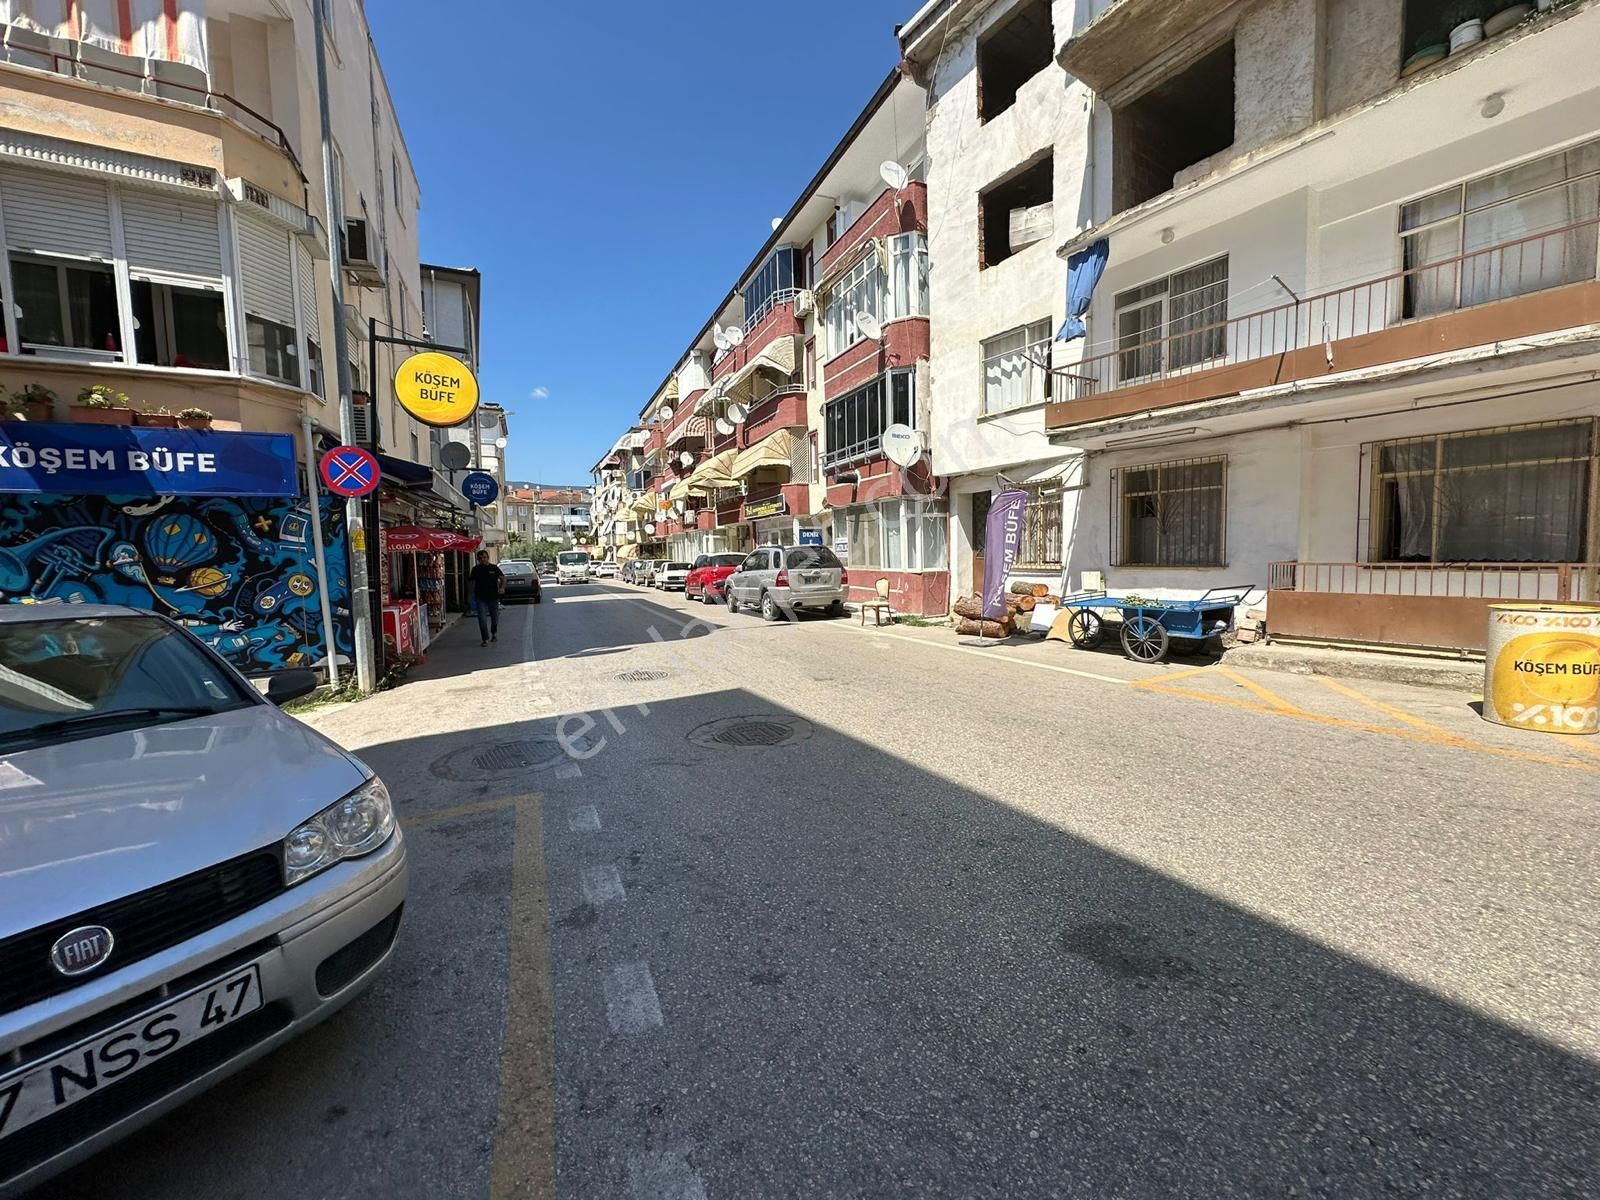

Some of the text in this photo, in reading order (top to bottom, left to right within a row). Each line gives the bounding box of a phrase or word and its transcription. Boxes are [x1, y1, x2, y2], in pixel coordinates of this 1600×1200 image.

[415, 371, 460, 389] KÖŞEM
[420, 387, 455, 403] BÜFE
[127, 447, 217, 473] BÜFE
[1004, 499, 1021, 545] BÜFE
[1514, 659, 1600, 676] KÖŞEM BÜF
[63, 934, 101, 966] FIAT
[50, 1012, 181, 1106] NSS
[200, 972, 252, 1028] 47
